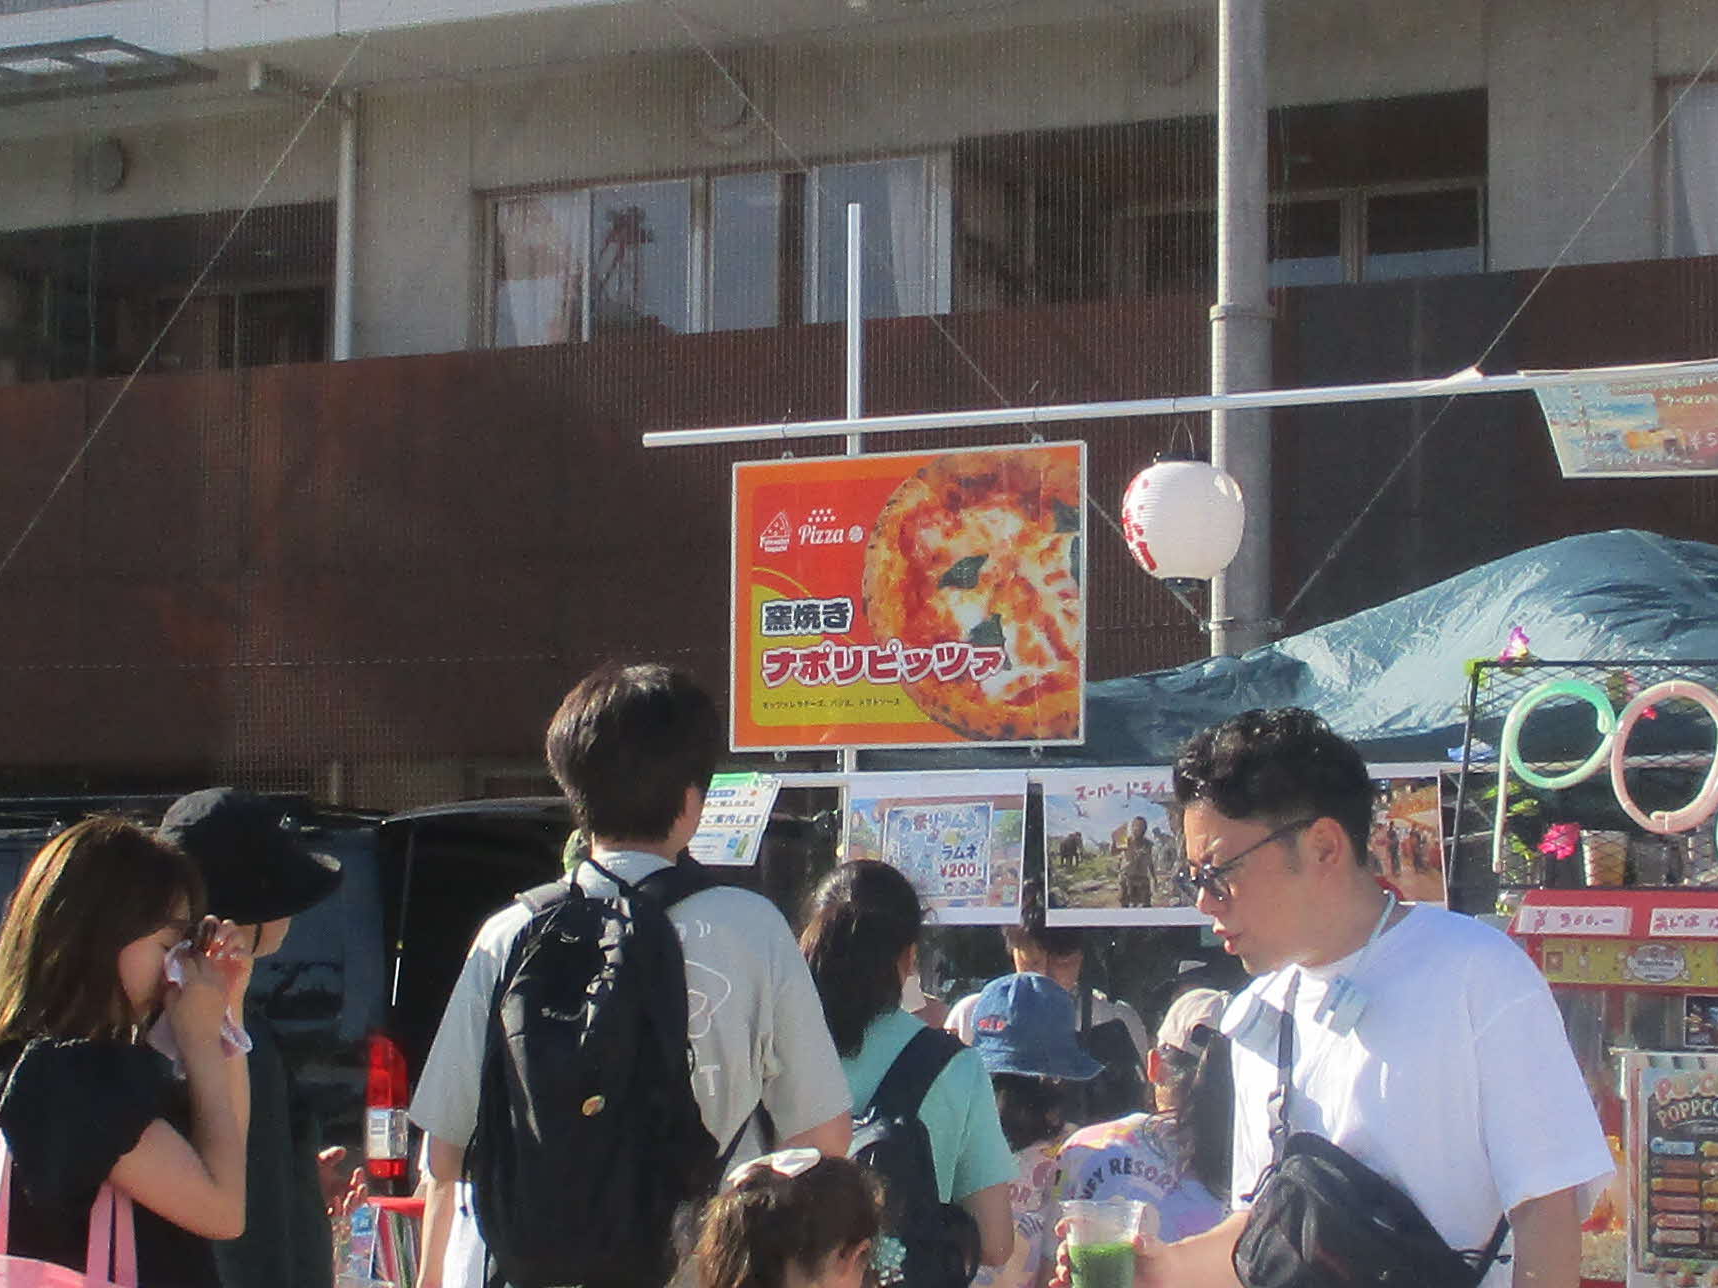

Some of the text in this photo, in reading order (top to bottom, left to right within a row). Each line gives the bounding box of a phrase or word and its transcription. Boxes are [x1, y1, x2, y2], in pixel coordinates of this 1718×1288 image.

[798, 523, 844, 545] Pizza
[762, 600, 853, 634] 窯焼き
[762, 639, 1007, 688] ナポリピッツァ
[939, 863, 977, 878] ¥200
